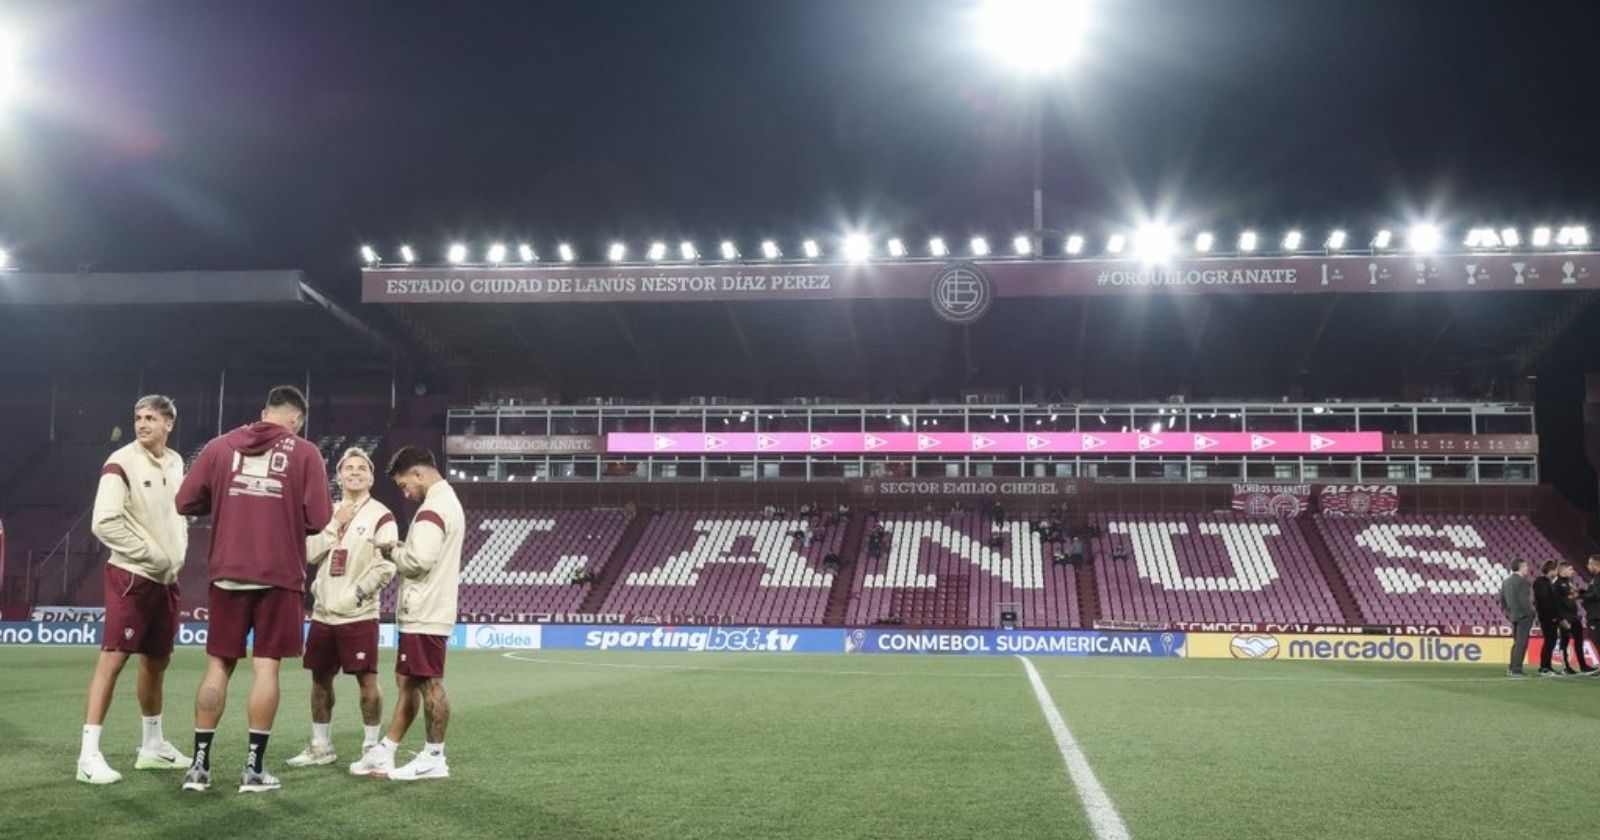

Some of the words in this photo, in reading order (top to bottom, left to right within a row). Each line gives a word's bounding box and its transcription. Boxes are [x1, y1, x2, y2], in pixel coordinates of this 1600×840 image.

[386, 278, 464, 294] ESTADIO
[470, 277, 542, 294] CIUDAD
[547, 277, 571, 293] DE
[575, 272, 636, 293] LANÚS
[641, 272, 716, 292] NÉSTOR
[722, 271, 766, 292] DÍAZ
[771, 270, 831, 291] PÉREZ
[1096, 268, 1297, 286] #ORGULLOGRANATE
[880, 482, 939, 495] SECTOR
[943, 482, 996, 495] EMILIO
[1321, 485, 1398, 496] ALMA
[0, 627, 33, 643] no
[37, 623, 97, 643] bank
[486, 630, 532, 646] Midea
[585, 626, 799, 652] sportingbet.tv
[878, 634, 990, 651] CONMEBOL
[996, 635, 1152, 653] SUDAMERICANA
[1288, 637, 1413, 659] mercado
[1420, 638, 1482, 661] libre
